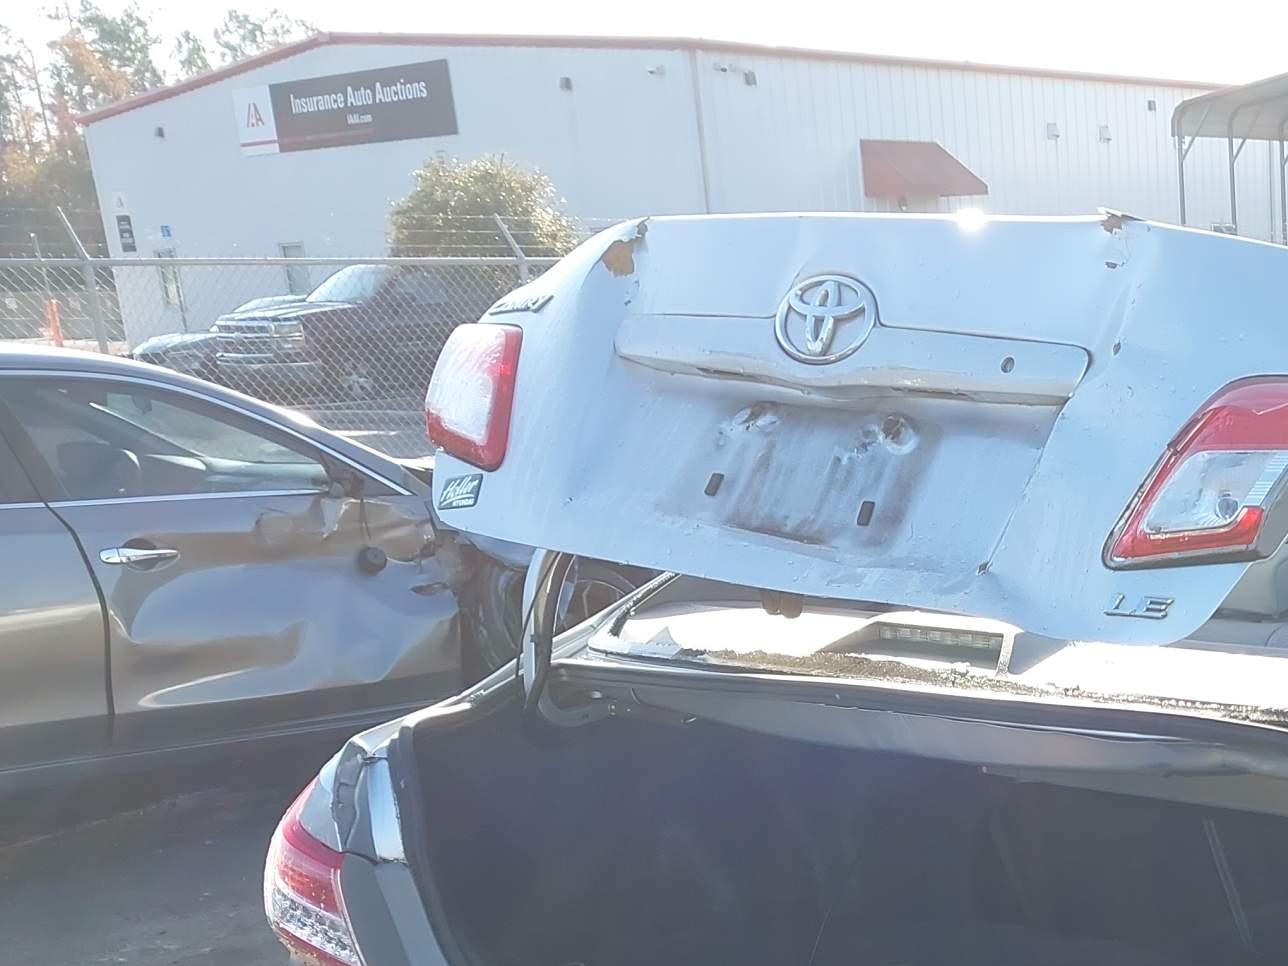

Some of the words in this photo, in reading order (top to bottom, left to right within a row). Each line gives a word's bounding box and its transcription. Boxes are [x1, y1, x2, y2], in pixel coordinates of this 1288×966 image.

[289, 93, 345, 114] Insurance
[346, 85, 373, 108] Auto
[375, 79, 428, 104] Auctions
[1103, 593, 1175, 621] LE
